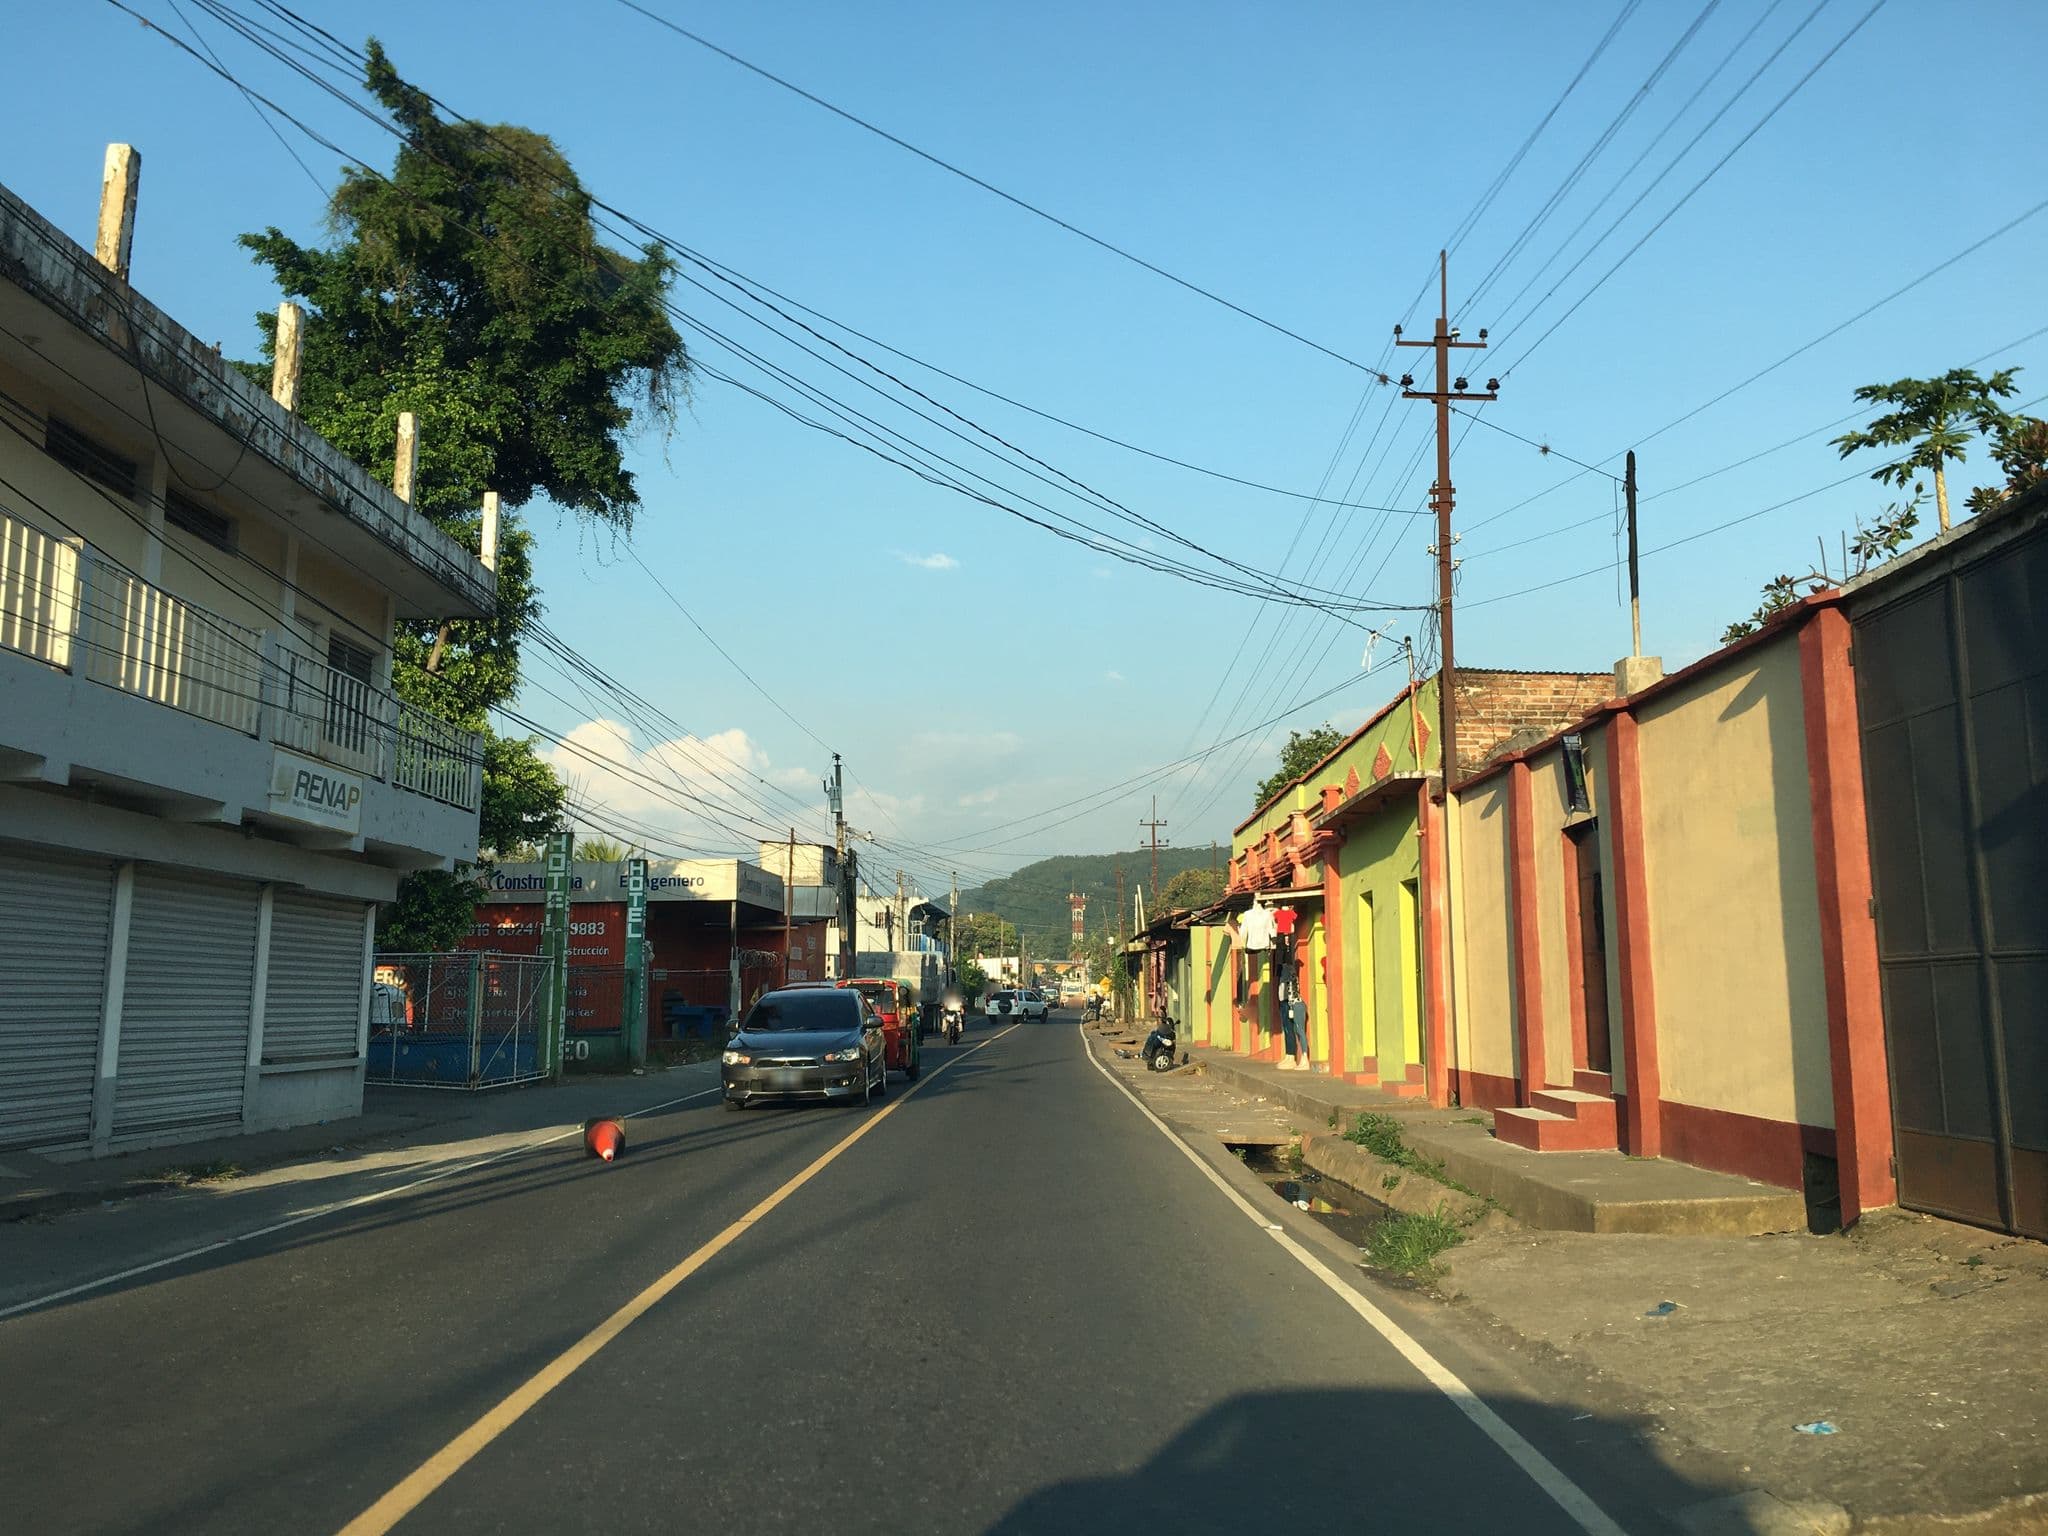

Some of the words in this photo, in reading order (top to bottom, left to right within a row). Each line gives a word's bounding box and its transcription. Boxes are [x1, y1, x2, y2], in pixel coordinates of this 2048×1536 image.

[293, 769, 361, 811] RENAP
[496, 873, 583, 891] Construa
[545, 834, 567, 932] HOTEL
[627, 861, 644, 938] HOTEL
[569, 921, 606, 936] 9883
